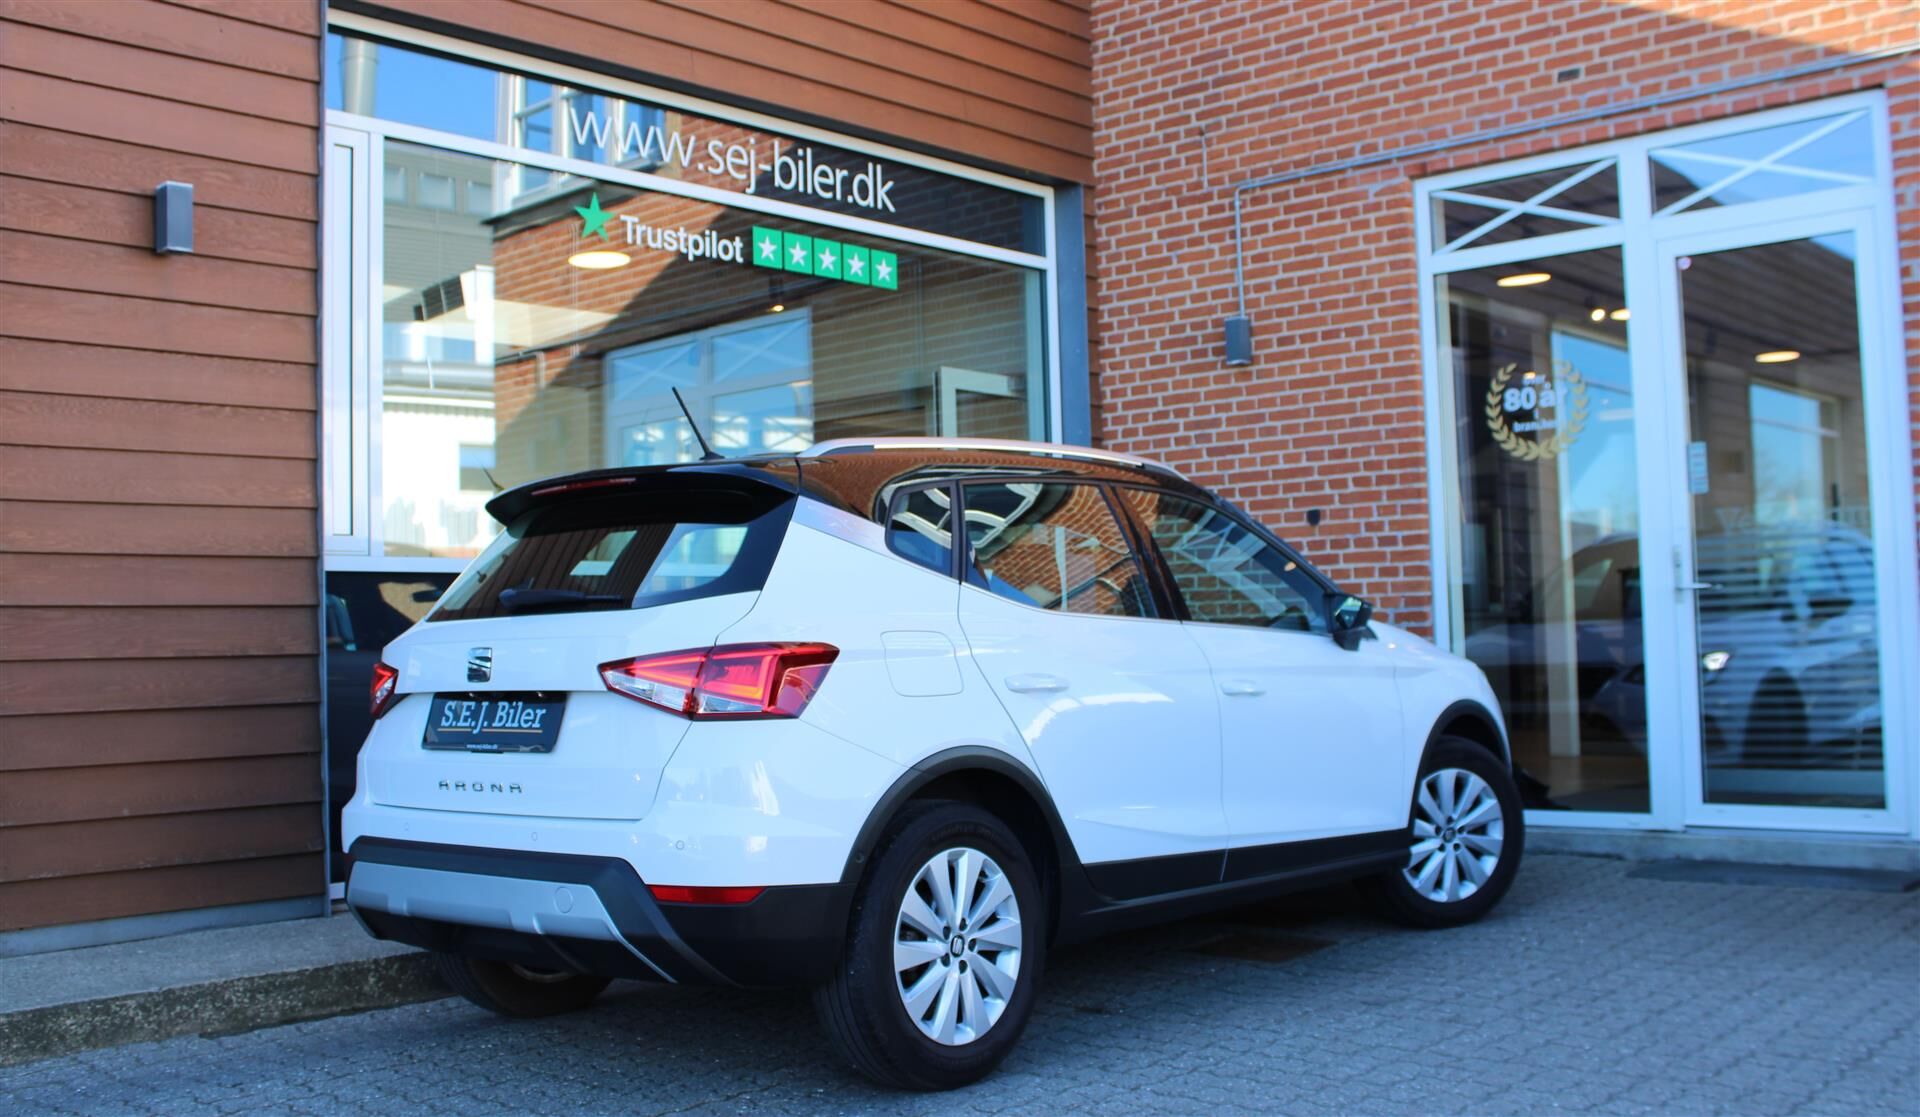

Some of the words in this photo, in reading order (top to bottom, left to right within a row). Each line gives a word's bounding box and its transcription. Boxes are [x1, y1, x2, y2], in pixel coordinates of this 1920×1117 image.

[570, 107, 897, 213] www.sej-biler.dk
[620, 214, 744, 264] Trustpilot
[1503, 386, 1537, 412] 80
[440, 701, 488, 734] S.E.J.
[492, 701, 547, 729] Biler
[438, 780, 523, 794] ARONA
